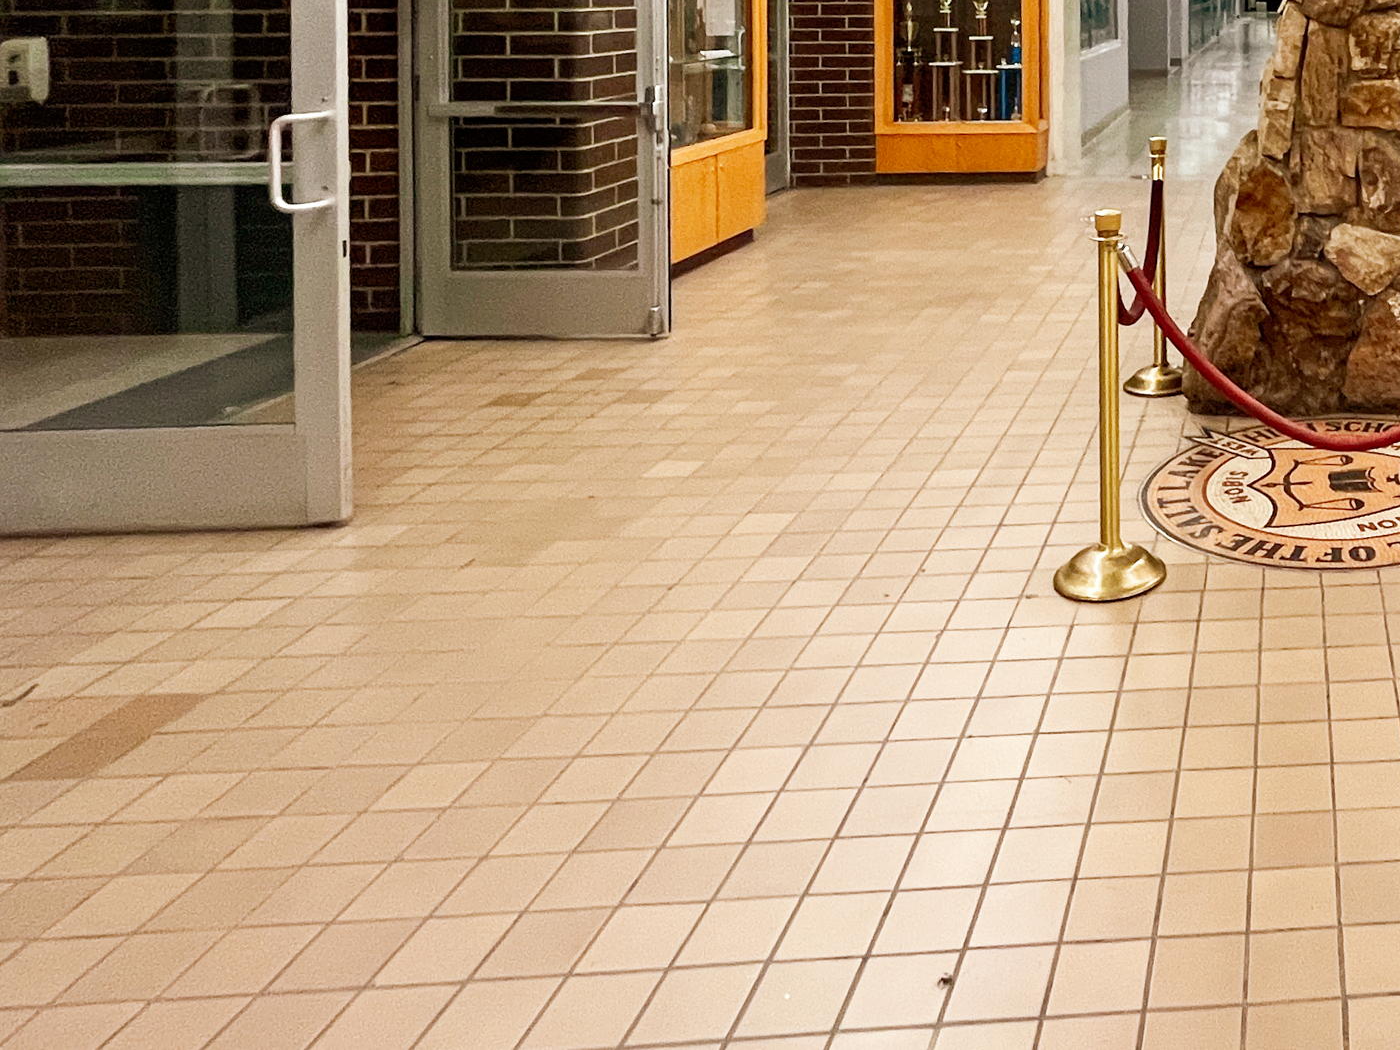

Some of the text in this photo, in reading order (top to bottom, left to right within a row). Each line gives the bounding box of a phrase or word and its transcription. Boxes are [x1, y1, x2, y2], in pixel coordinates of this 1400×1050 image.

[1212, 437, 1260, 456] WEST
[1158, 447, 1225, 490] LAKE
[1222, 471, 1252, 504] NOBIS
[1157, 498, 1225, 539] SALT
[1214, 533, 1308, 564] THE
[1316, 545, 1376, 562] OF
